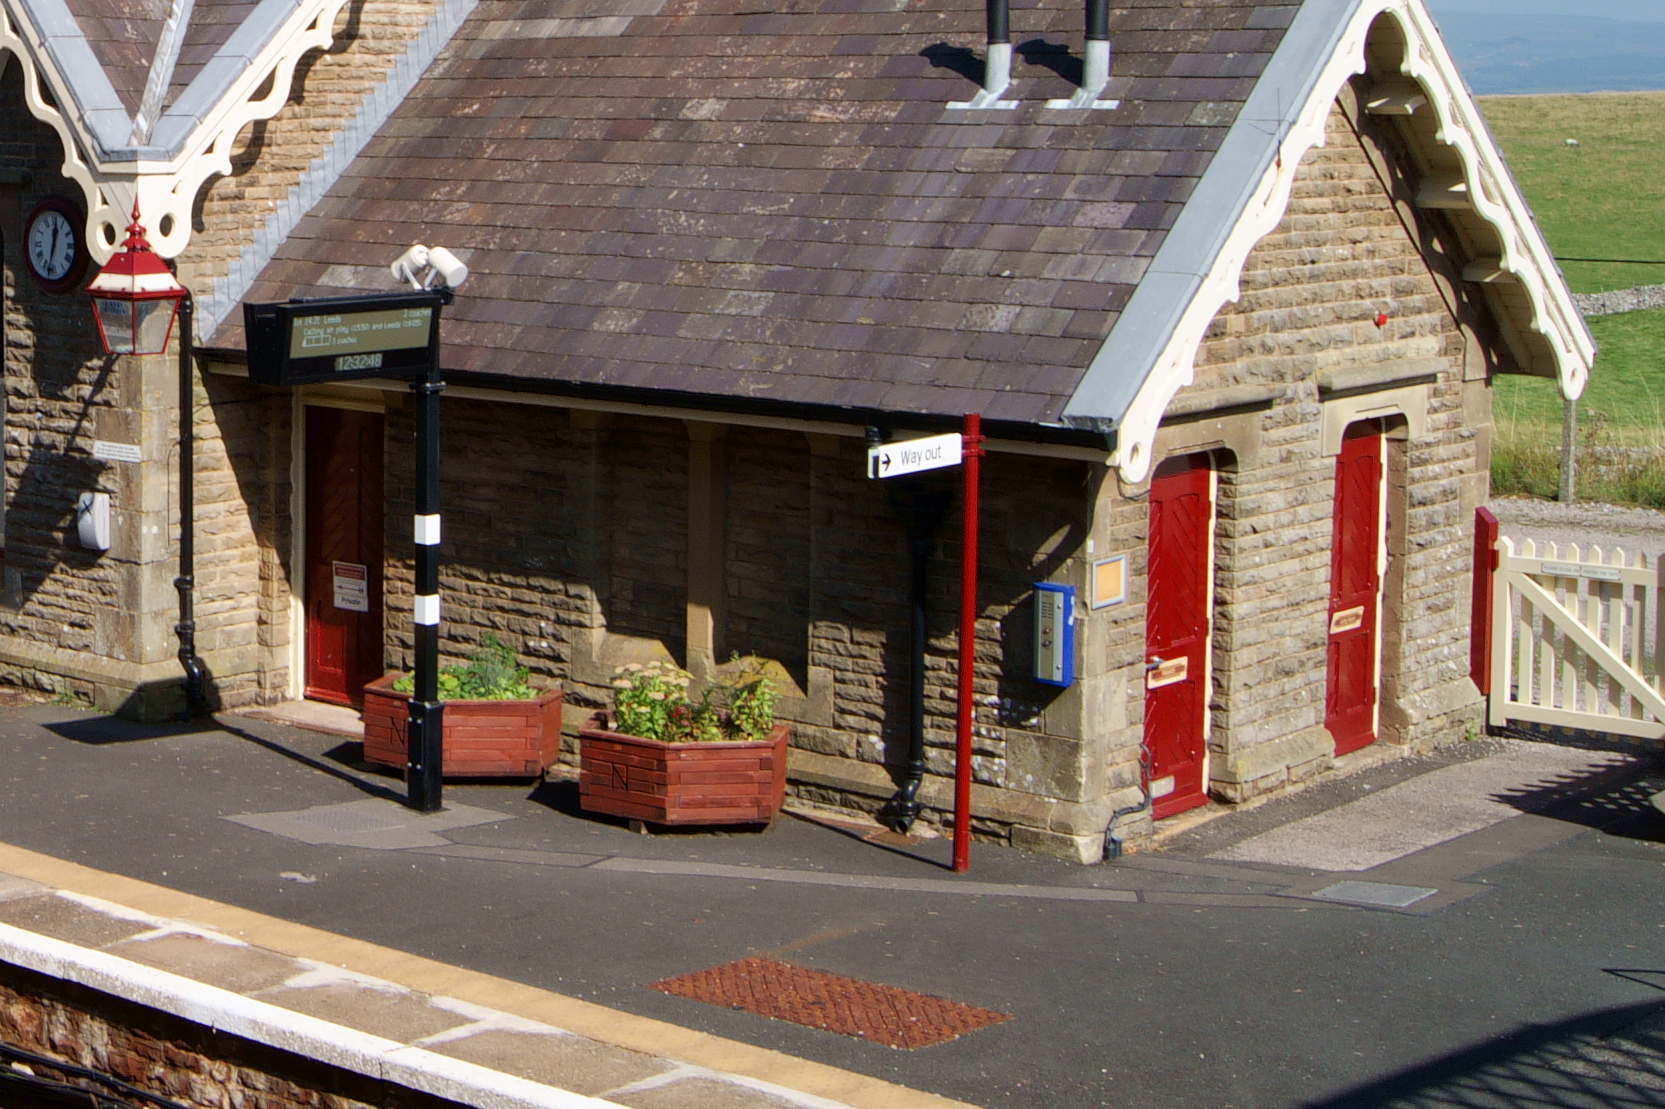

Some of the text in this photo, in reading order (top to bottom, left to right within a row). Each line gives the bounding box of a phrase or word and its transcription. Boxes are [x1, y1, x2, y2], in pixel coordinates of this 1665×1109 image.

[338, 353, 382, 371] 12:32:48
[901, 444, 941, 466] Way out
